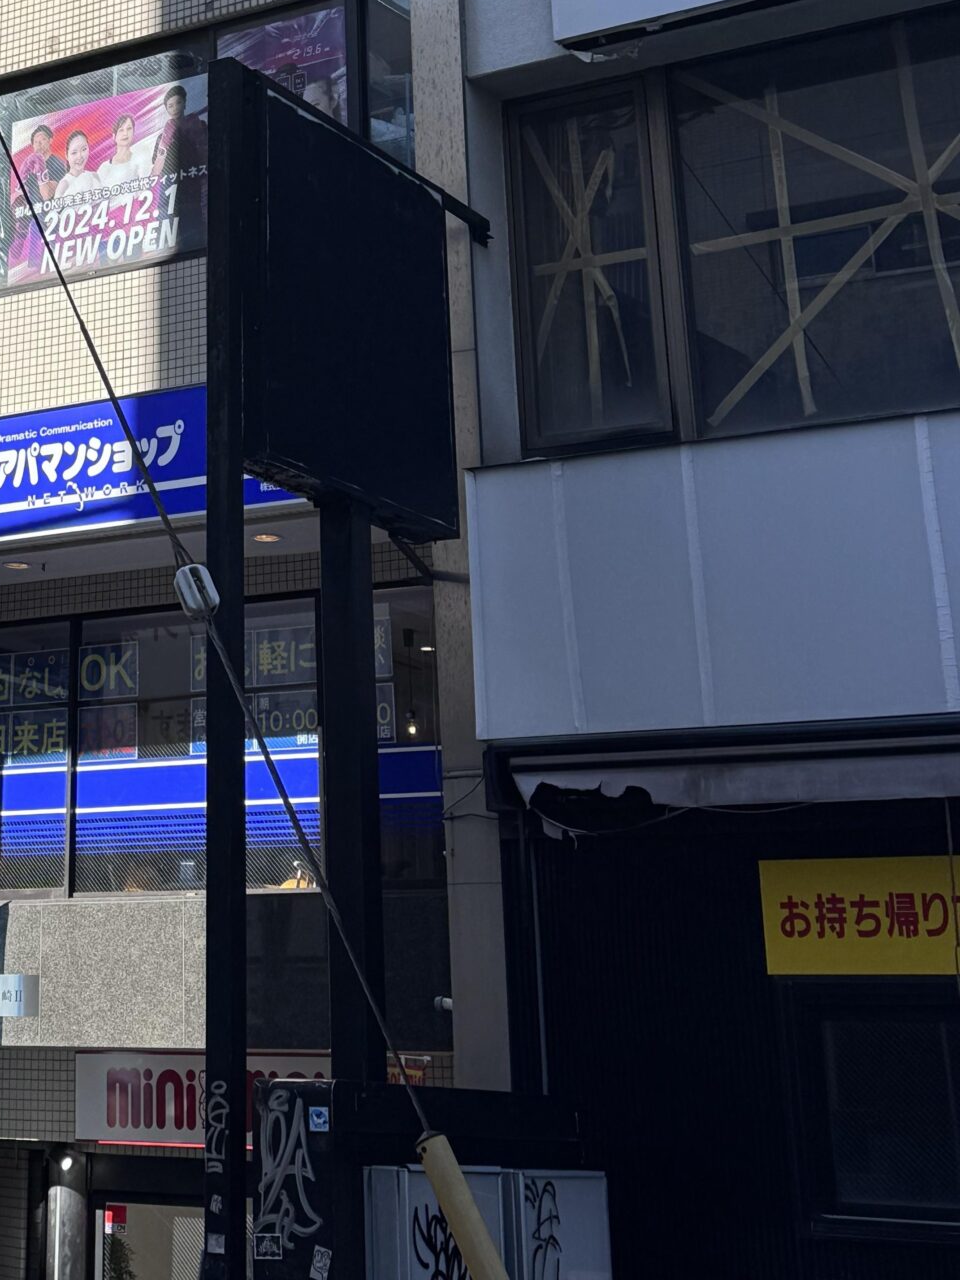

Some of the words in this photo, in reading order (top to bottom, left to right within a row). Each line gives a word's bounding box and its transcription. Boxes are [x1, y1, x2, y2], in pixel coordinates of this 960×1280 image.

[40, 230, 102, 275] NEW
[106, 217, 179, 261] OPEN
[40, 418, 113, 436] Communication
[780, 892, 960, 939] お持ち帰り
